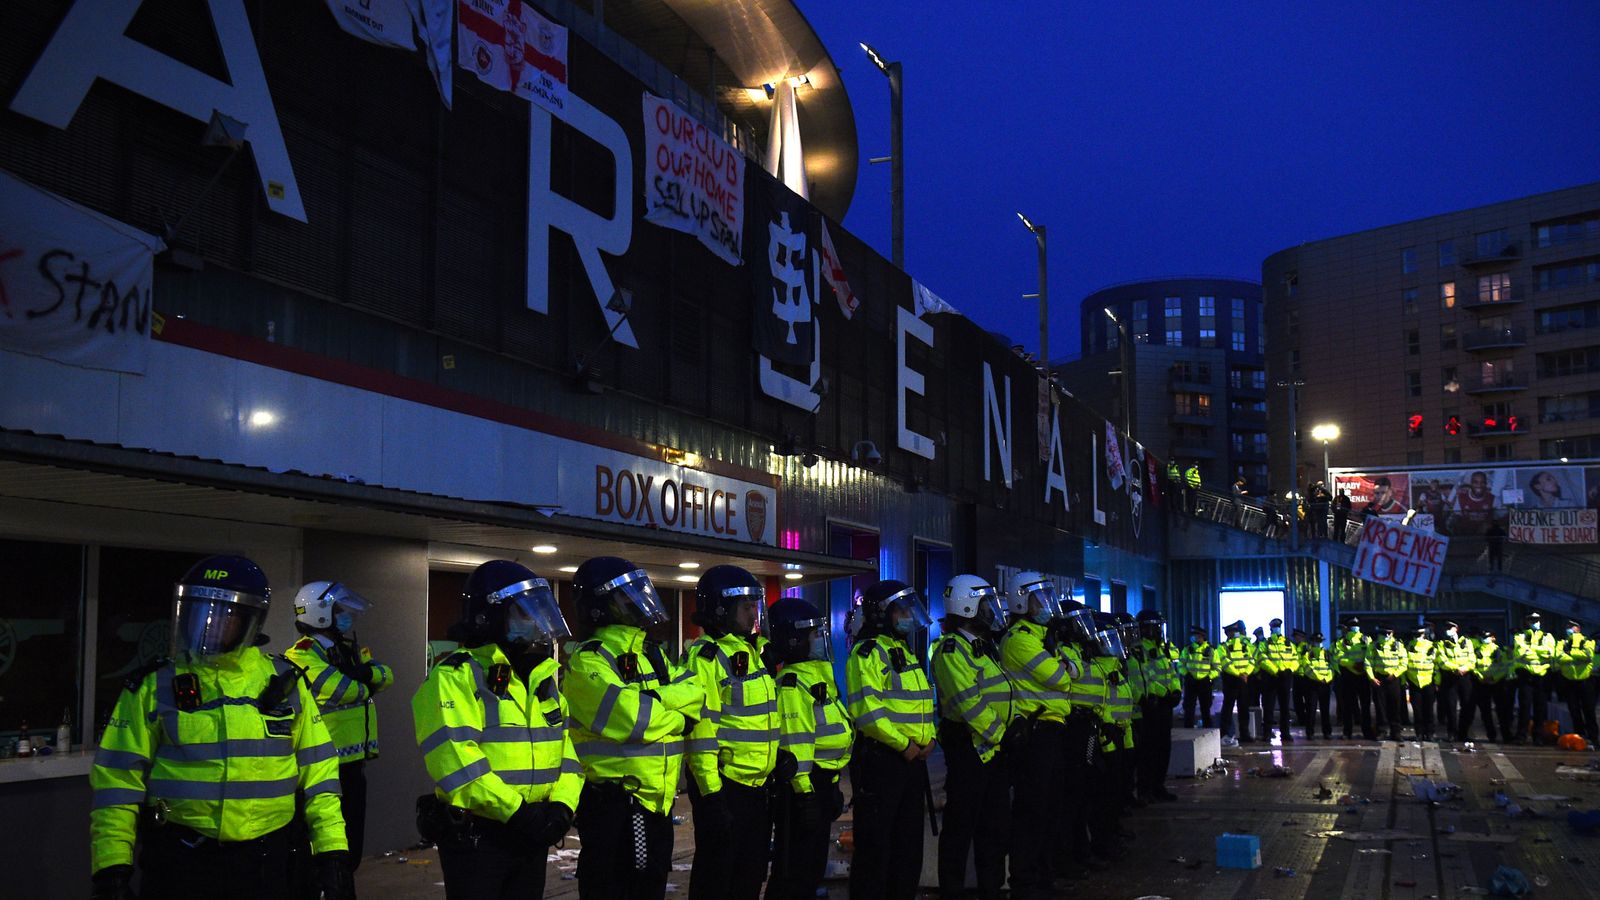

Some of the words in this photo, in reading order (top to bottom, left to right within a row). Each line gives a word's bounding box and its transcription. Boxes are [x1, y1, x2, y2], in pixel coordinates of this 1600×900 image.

[655, 105, 694, 149] OUR
[695, 123, 737, 186] CLUB
[656, 143, 691, 180] OUR
[693, 155, 738, 222] HOME
[690, 191, 710, 229] UP
[595, 464, 656, 523] BOX
[660, 478, 738, 536] OFFICE
[1509, 510, 1554, 527] KROENKE
[1559, 510, 1579, 527] OUT
[1361, 517, 1446, 566] KROENKE
[1509, 527, 1535, 543] SACK
[1540, 527, 1561, 542] THE
[1563, 527, 1597, 542] BOARD
[190, 586, 223, 600] POLICE
[203, 568, 230, 580] MP
